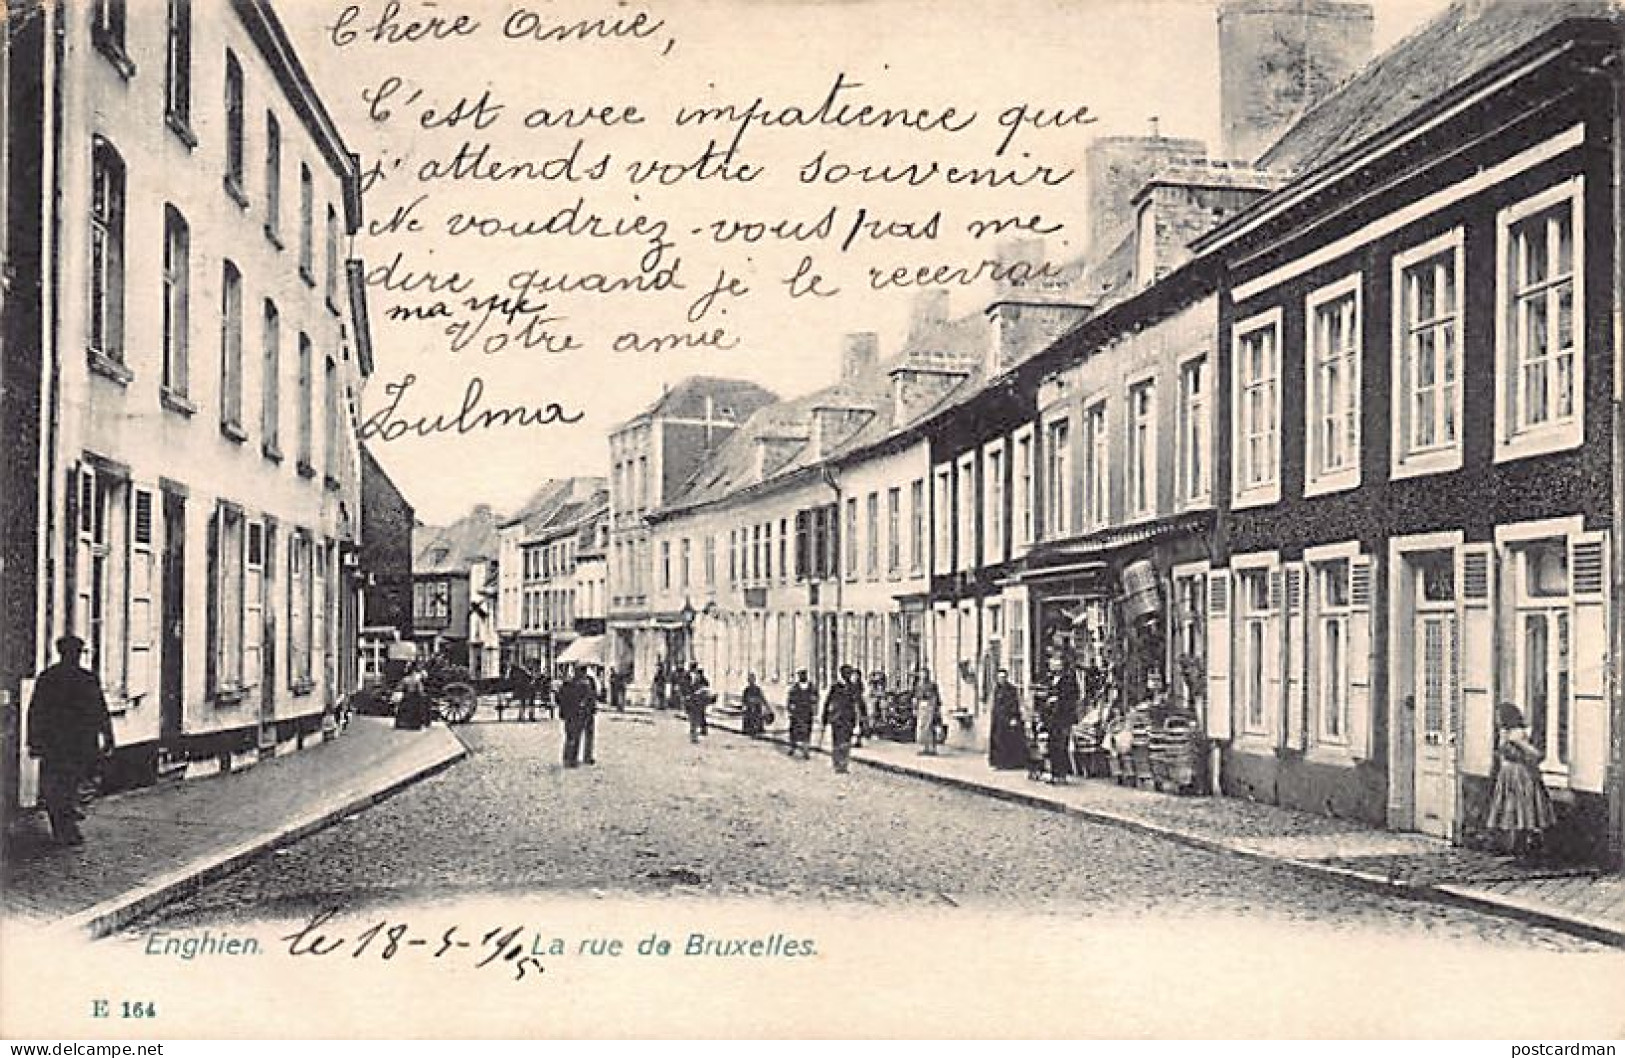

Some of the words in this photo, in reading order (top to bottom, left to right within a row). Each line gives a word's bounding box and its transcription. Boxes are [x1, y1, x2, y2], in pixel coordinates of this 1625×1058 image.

[524, 104, 646, 129] avec
[675, 73, 976, 165] impatience
[997, 103, 1098, 156] que
[626, 140, 764, 186] votre
[800, 150, 1074, 187] souvenir
[841, 208, 941, 251] pas
[967, 215, 1064, 239] me
[363, 248, 474, 291] dire
[509, 258, 686, 324] quand
[688, 257, 750, 323] je
[783, 256, 839, 298] le
[868, 240, 1063, 289] recevrai
[385, 301, 454, 321] ma
[445, 312, 583, 354] Votre
[613, 328, 741, 352] amie
[281, 906, 344, 956] le
